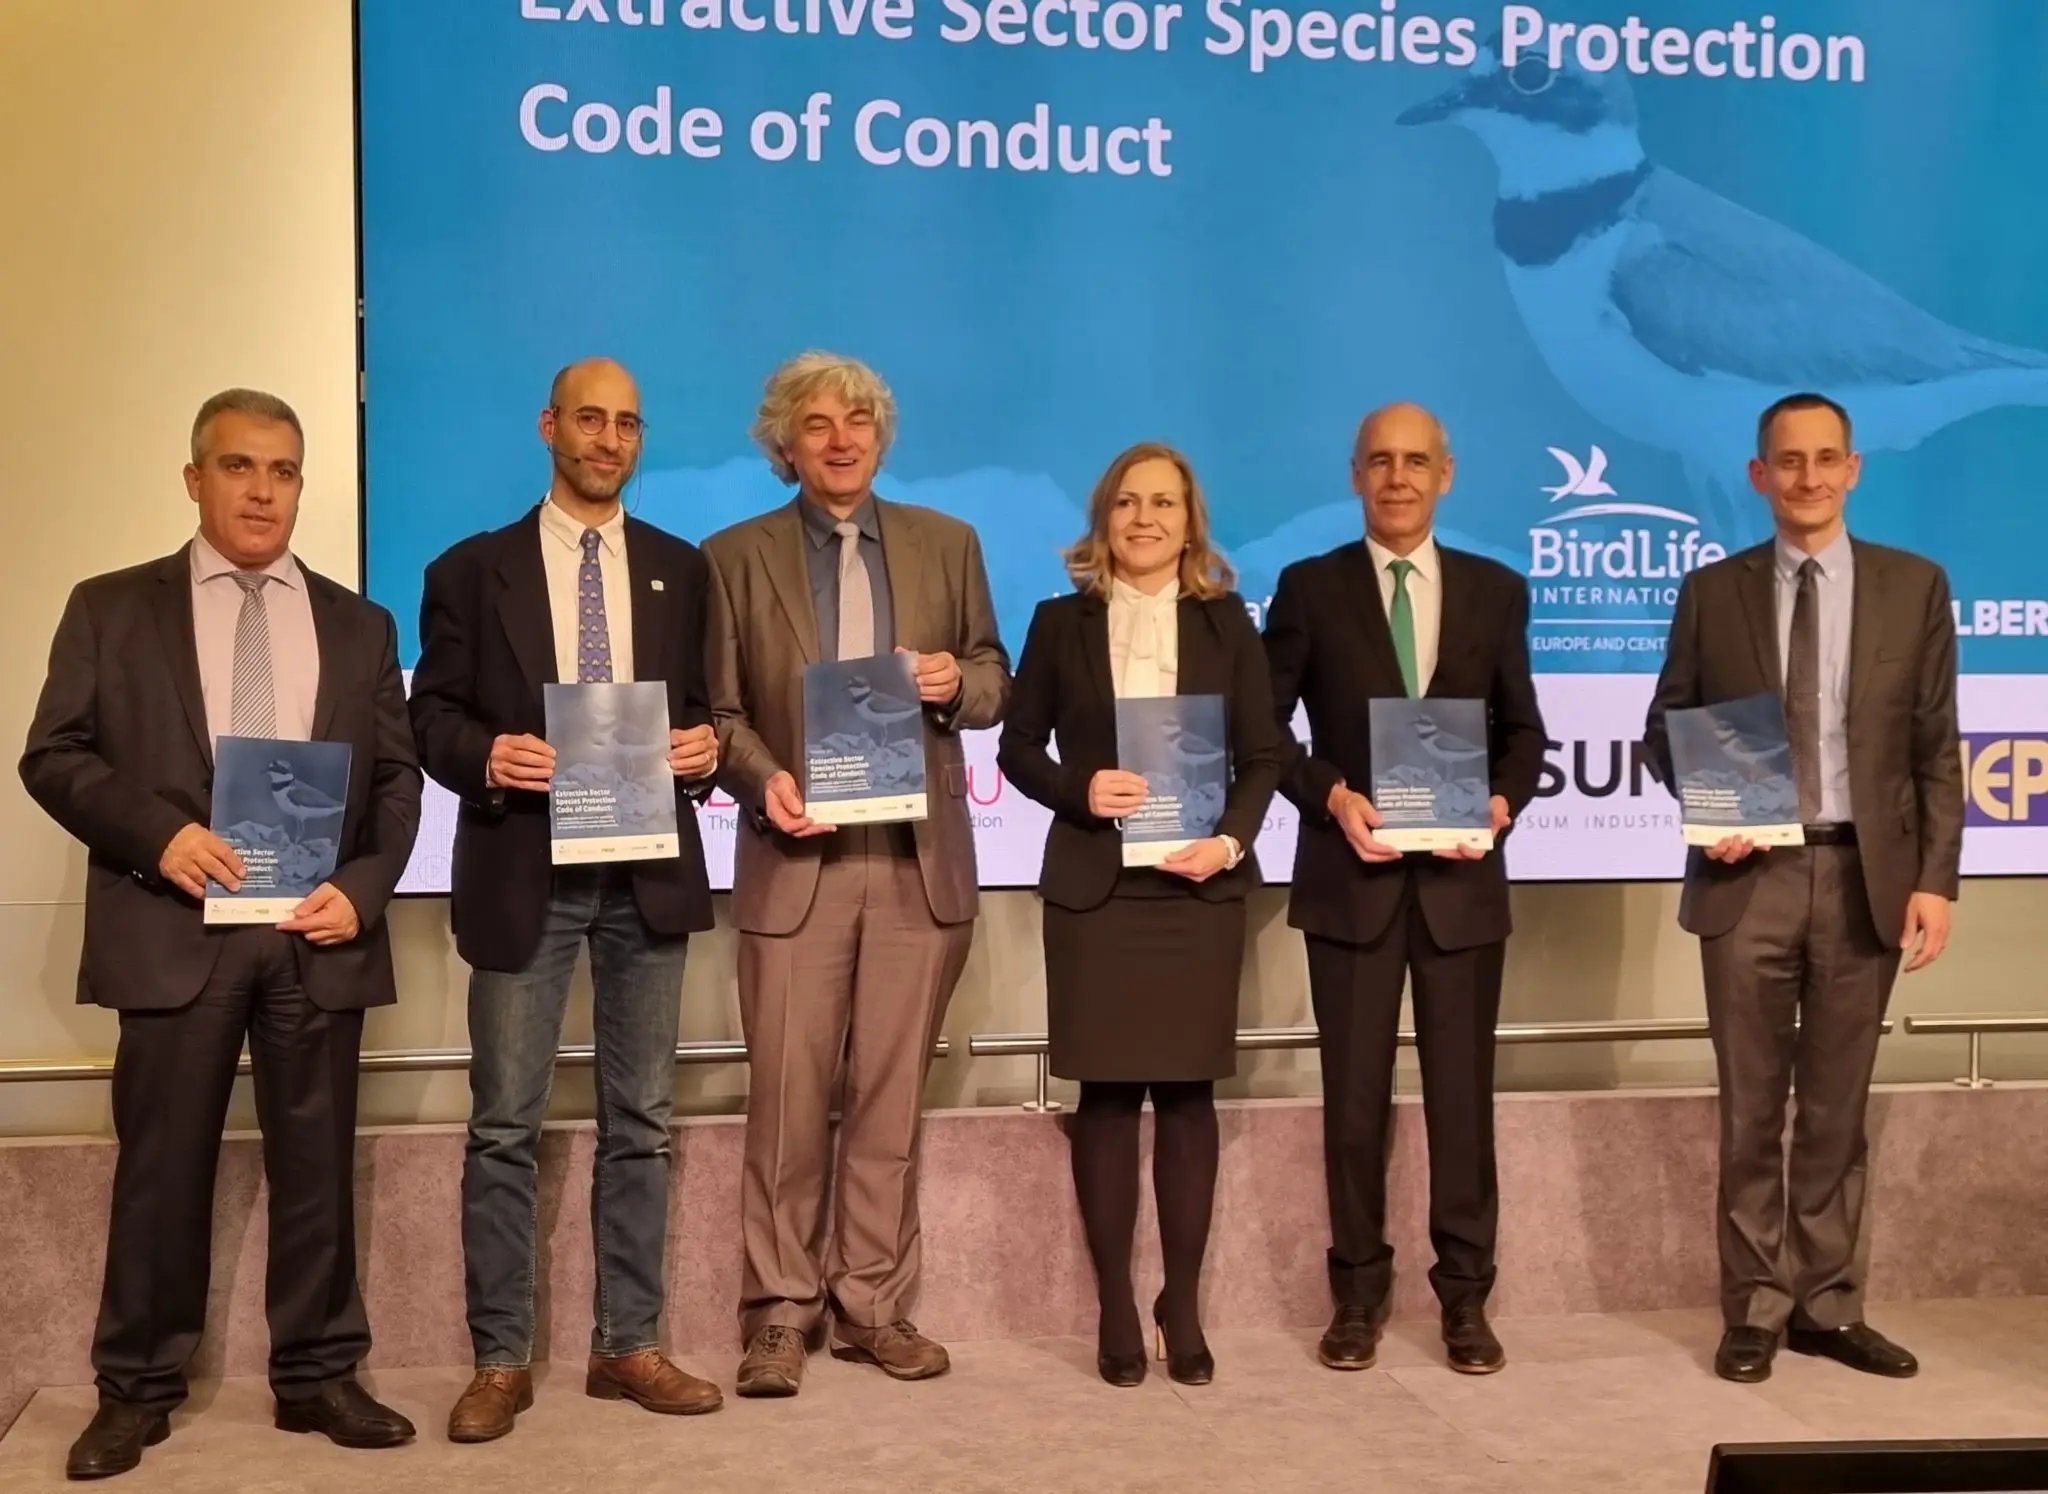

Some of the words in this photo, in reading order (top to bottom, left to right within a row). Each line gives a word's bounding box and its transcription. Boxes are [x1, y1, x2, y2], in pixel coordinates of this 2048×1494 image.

[940, 0, 1184, 51] Sector
[1204, 0, 1477, 72] Species
[1502, 6, 1866, 83] Protection
[518, 83, 724, 158] Code
[749, 91, 832, 162] of
[853, 98, 1173, 177] Conduct
[1532, 586, 1679, 606] INTERNATIO
[1951, 599, 2048, 637] LBER
[1532, 635, 1591, 652] EUROPE
[1593, 635, 1625, 652] AND
[1627, 635, 1668, 652] CENT
[1584, 814, 1680, 829] INDUSTR
